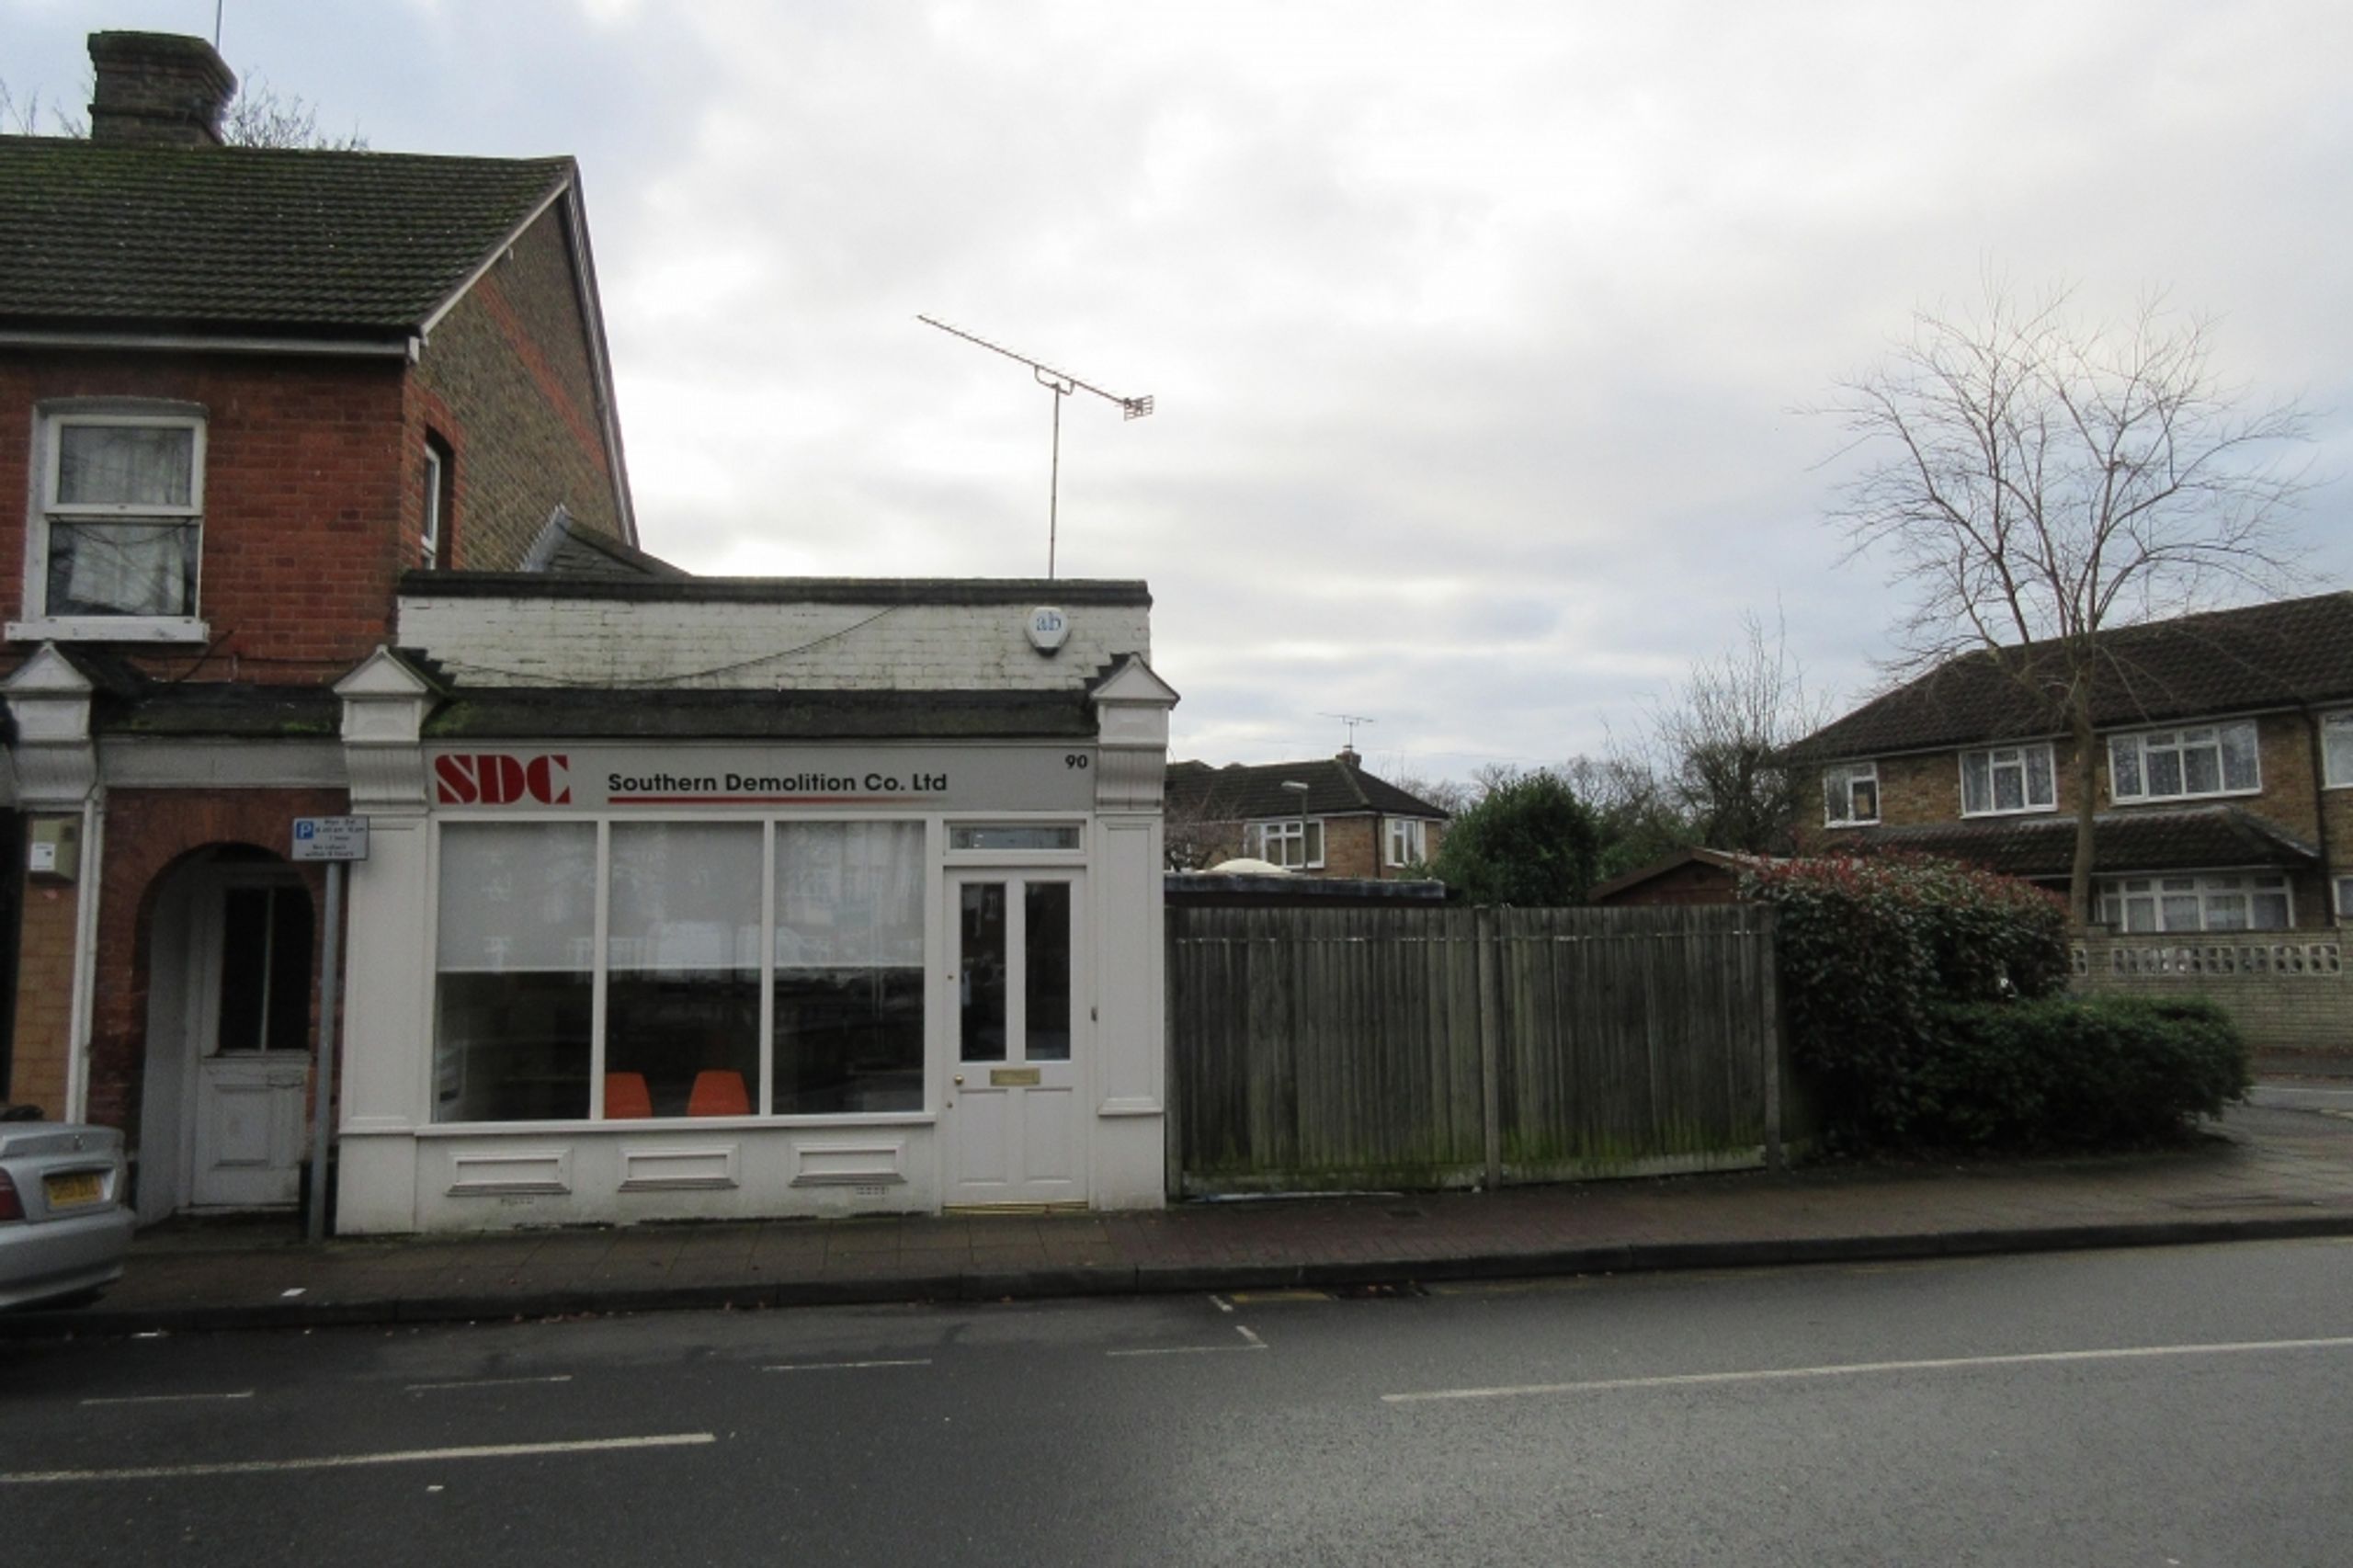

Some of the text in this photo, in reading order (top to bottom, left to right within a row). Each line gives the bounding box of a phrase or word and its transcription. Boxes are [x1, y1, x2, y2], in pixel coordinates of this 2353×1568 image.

[1065, 755, 1088, 769] 90
[435, 755, 571, 804] SDC
[608, 773, 948, 791] Southern Demolition Co. Ltd
